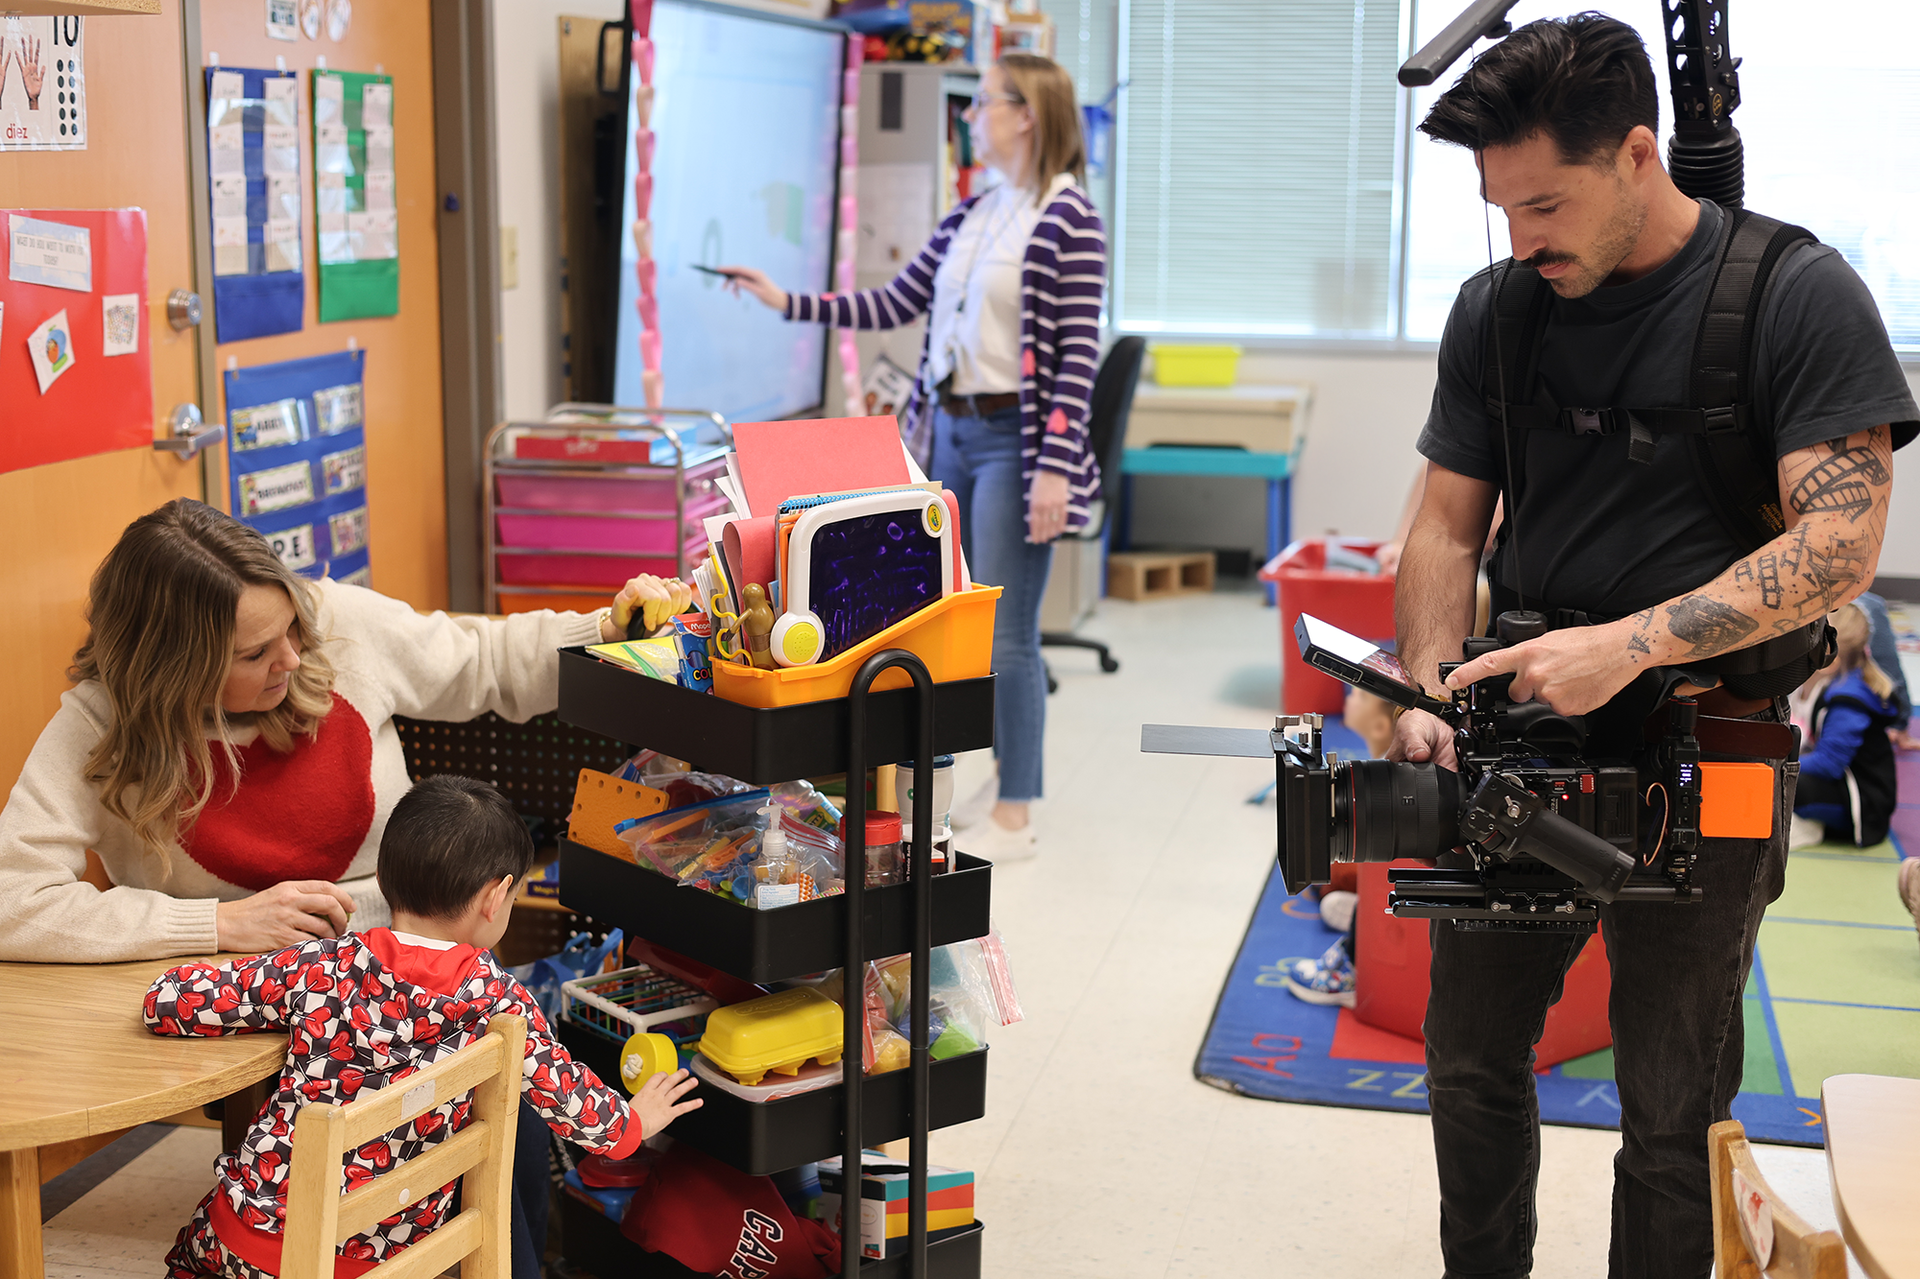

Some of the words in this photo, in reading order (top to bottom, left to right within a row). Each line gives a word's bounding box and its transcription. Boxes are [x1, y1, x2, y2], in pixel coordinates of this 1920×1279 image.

[53, 16, 79, 47] 10
[6, 124, 28, 139] diez
[693, 667, 713, 681] COL
[715, 1208, 784, 1279] CAP
